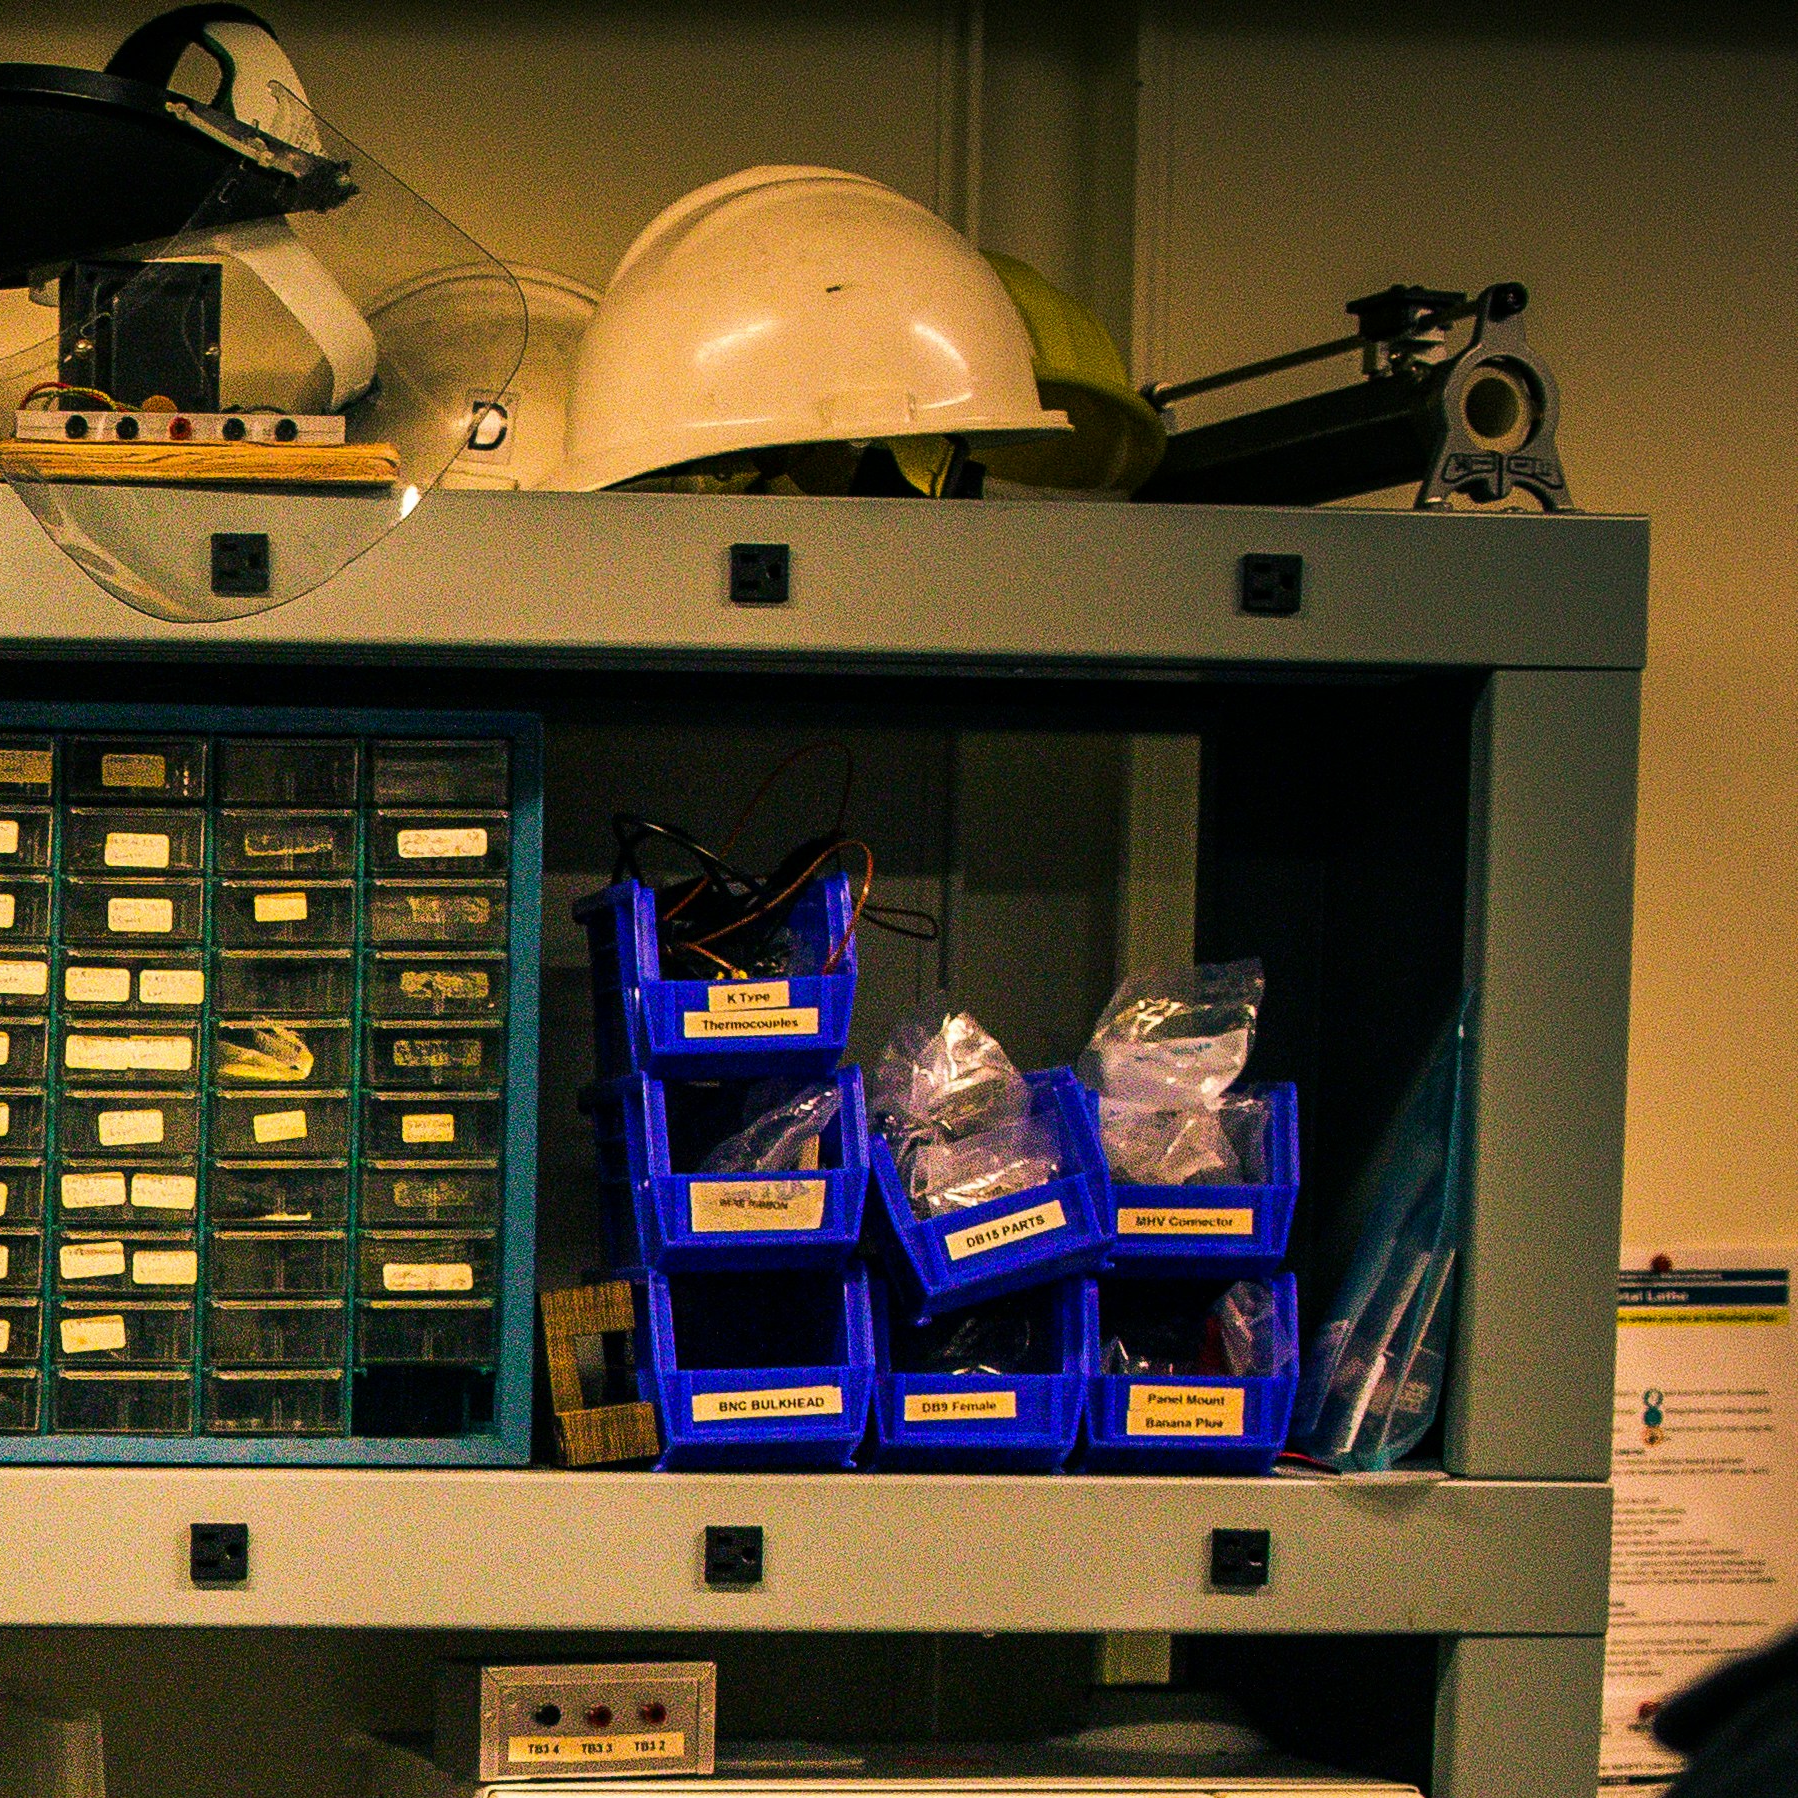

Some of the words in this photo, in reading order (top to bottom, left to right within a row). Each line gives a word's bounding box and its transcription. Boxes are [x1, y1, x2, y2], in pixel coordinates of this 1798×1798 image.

[726, 993, 736, 1003] K
[739, 991, 771, 1005] Type
[702, 1018, 799, 1031] Thermocouples
[1001, 1214, 1045, 1238] PARTS
[1136, 1215, 1165, 1228] MHV
[1168, 1215, 1234, 1228] Connector
[1619, 1291, 1643, 1302] tal
[718, 1400, 749, 1412] BNC
[751, 1395, 825, 1411] BULKHEAD
[1148, 1392, 1183, 1405] Panel
[1186, 1393, 1225, 1406] Mount
[921, 1401, 948, 1415] DB9
[951, 1400, 997, 1413] Female
[1145, 1417, 1186, 1430] Banana
